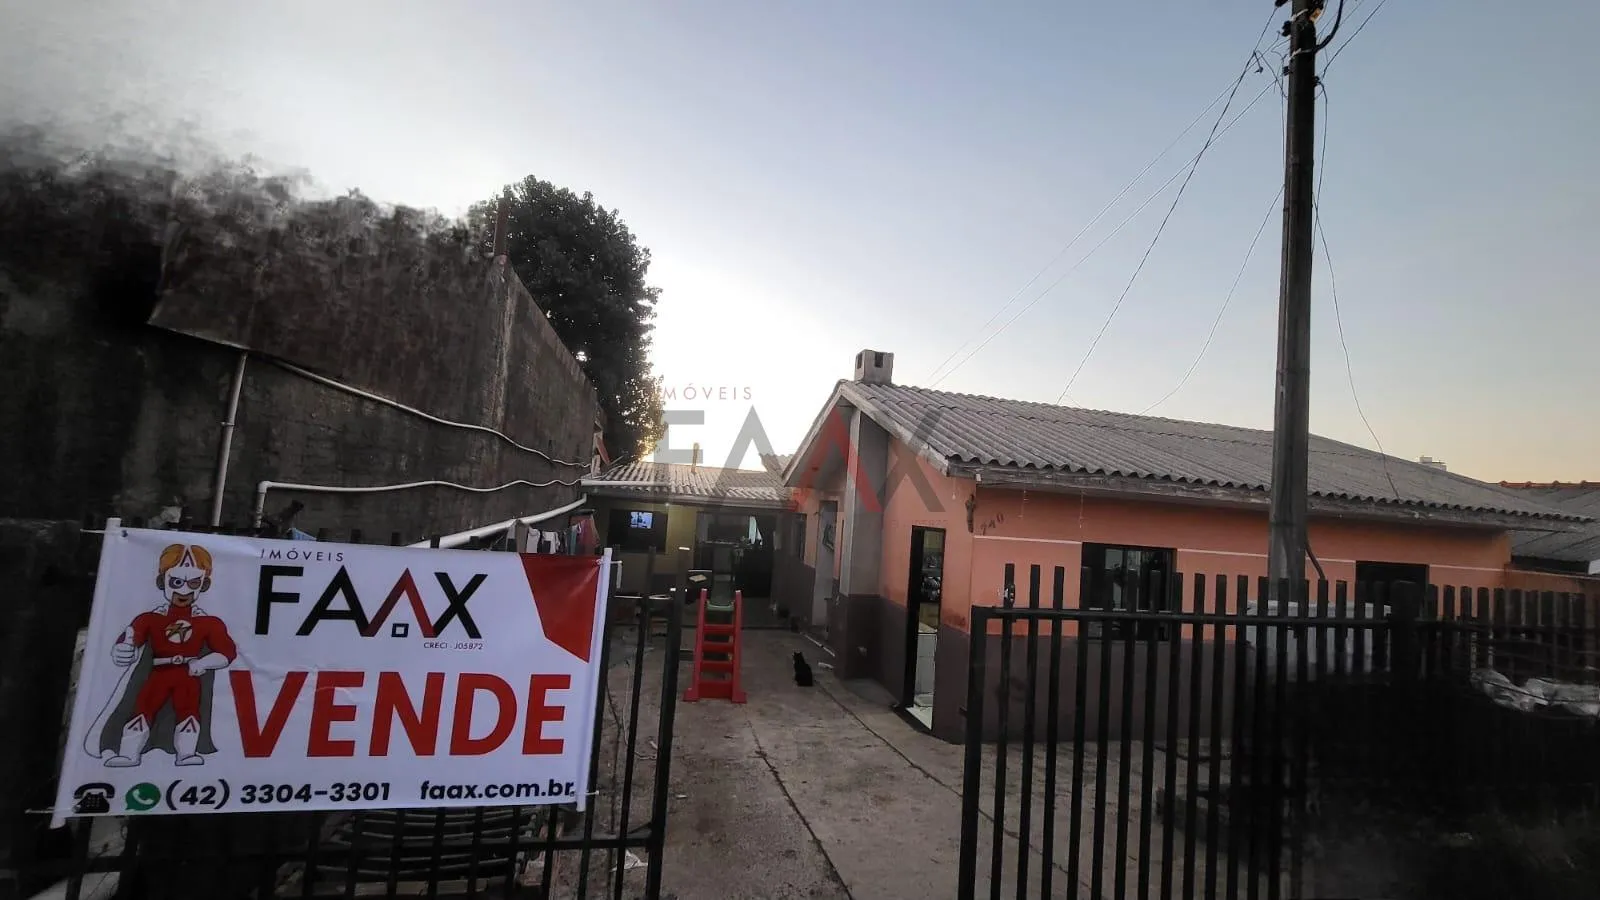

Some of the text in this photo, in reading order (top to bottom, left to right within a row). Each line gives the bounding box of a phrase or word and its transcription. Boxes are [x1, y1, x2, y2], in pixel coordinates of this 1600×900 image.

[260, 547, 345, 563] IMÓVEIS
[254, 564, 488, 640] FAAX
[423, 641, 448, 650] CRECI
[454, 642, 484, 651] J05872
[229, 670, 571, 758] VENDE
[165, 778, 230, 811] (42)
[240, 782, 391, 804] 3304-3301
